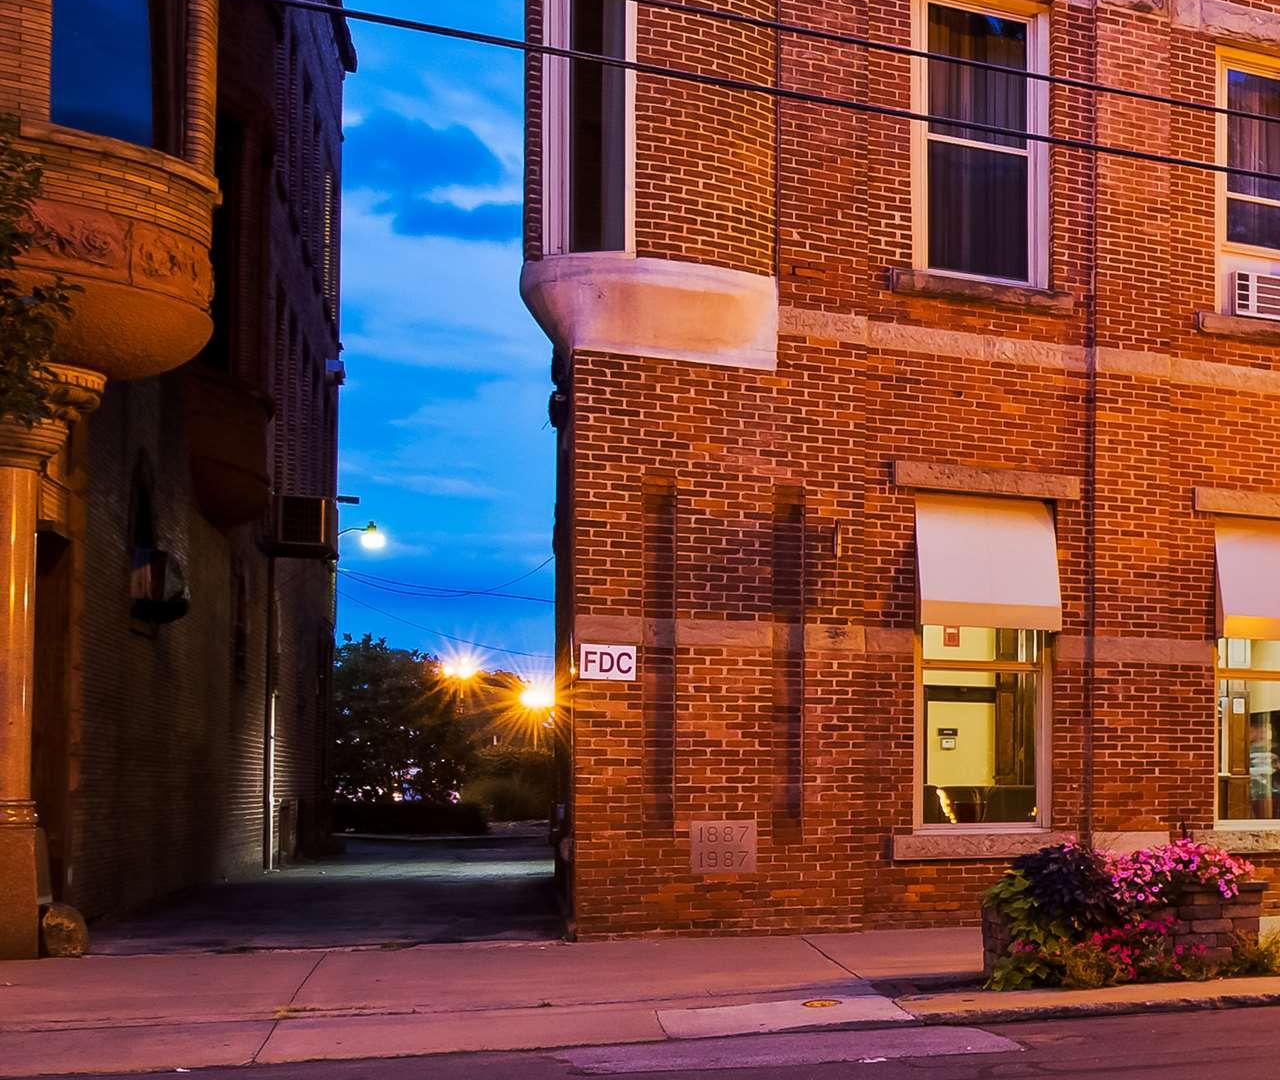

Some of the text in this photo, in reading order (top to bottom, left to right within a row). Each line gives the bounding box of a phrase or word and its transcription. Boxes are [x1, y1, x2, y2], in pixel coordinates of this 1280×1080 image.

[584, 651, 633, 674] FDC
[697, 826, 749, 843] 1887
[698, 851, 749, 868] 1987
